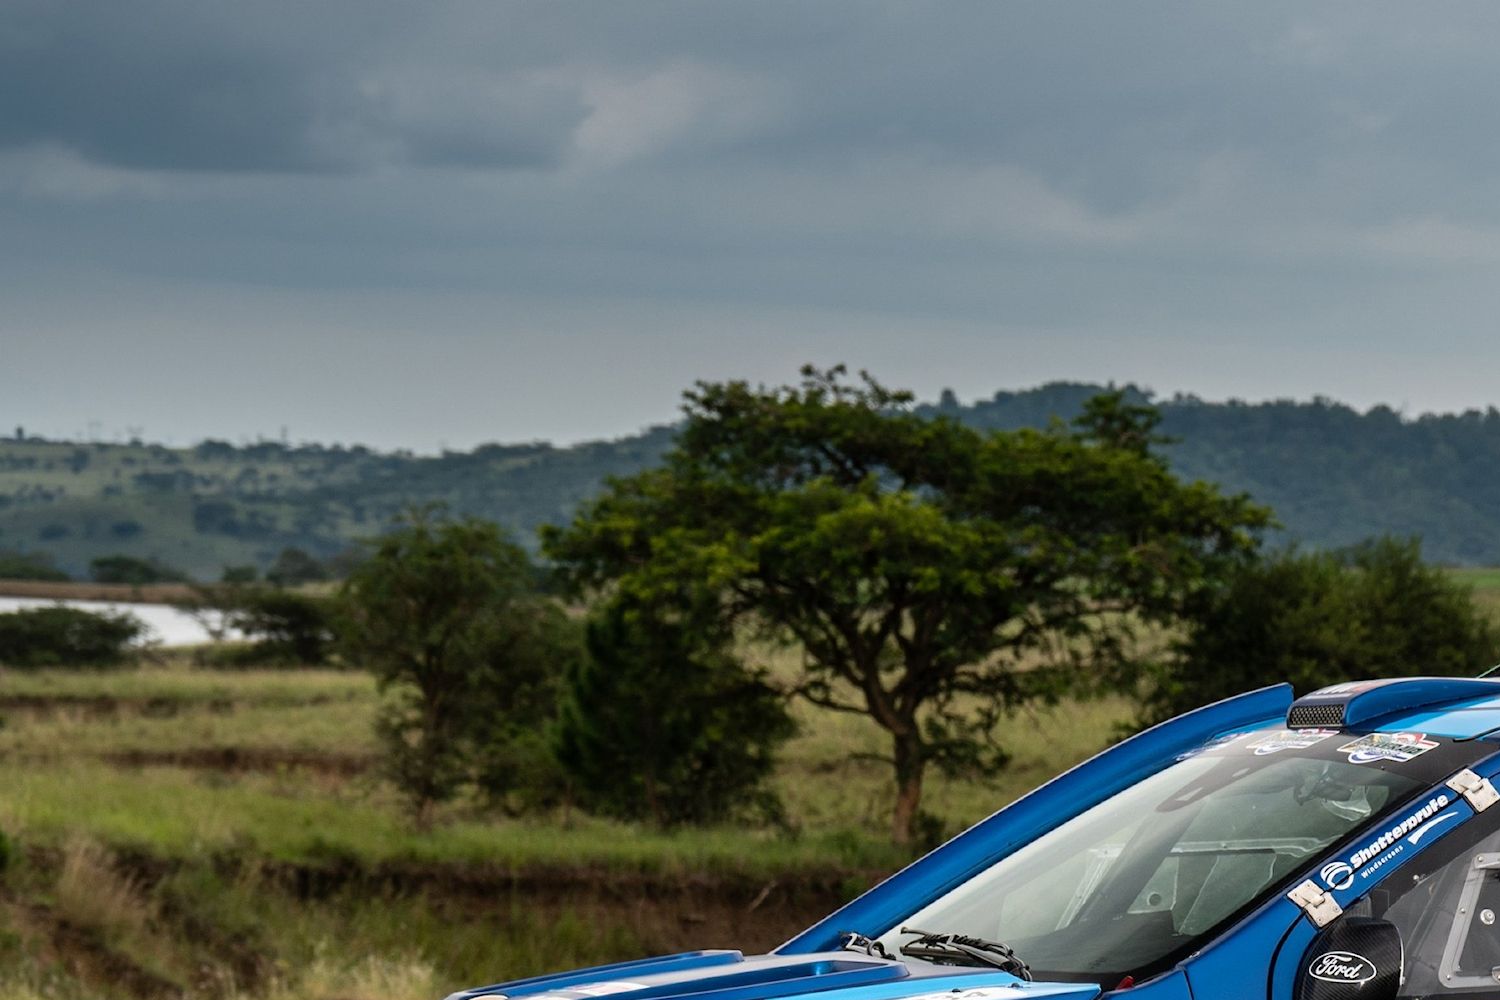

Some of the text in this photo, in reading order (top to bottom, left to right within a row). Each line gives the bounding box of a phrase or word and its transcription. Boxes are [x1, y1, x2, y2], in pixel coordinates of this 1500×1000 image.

[1350, 794, 1449, 869] Shatterprufe
[1361, 845, 1404, 878] Windscreens
[1315, 954, 1364, 979] Ford
